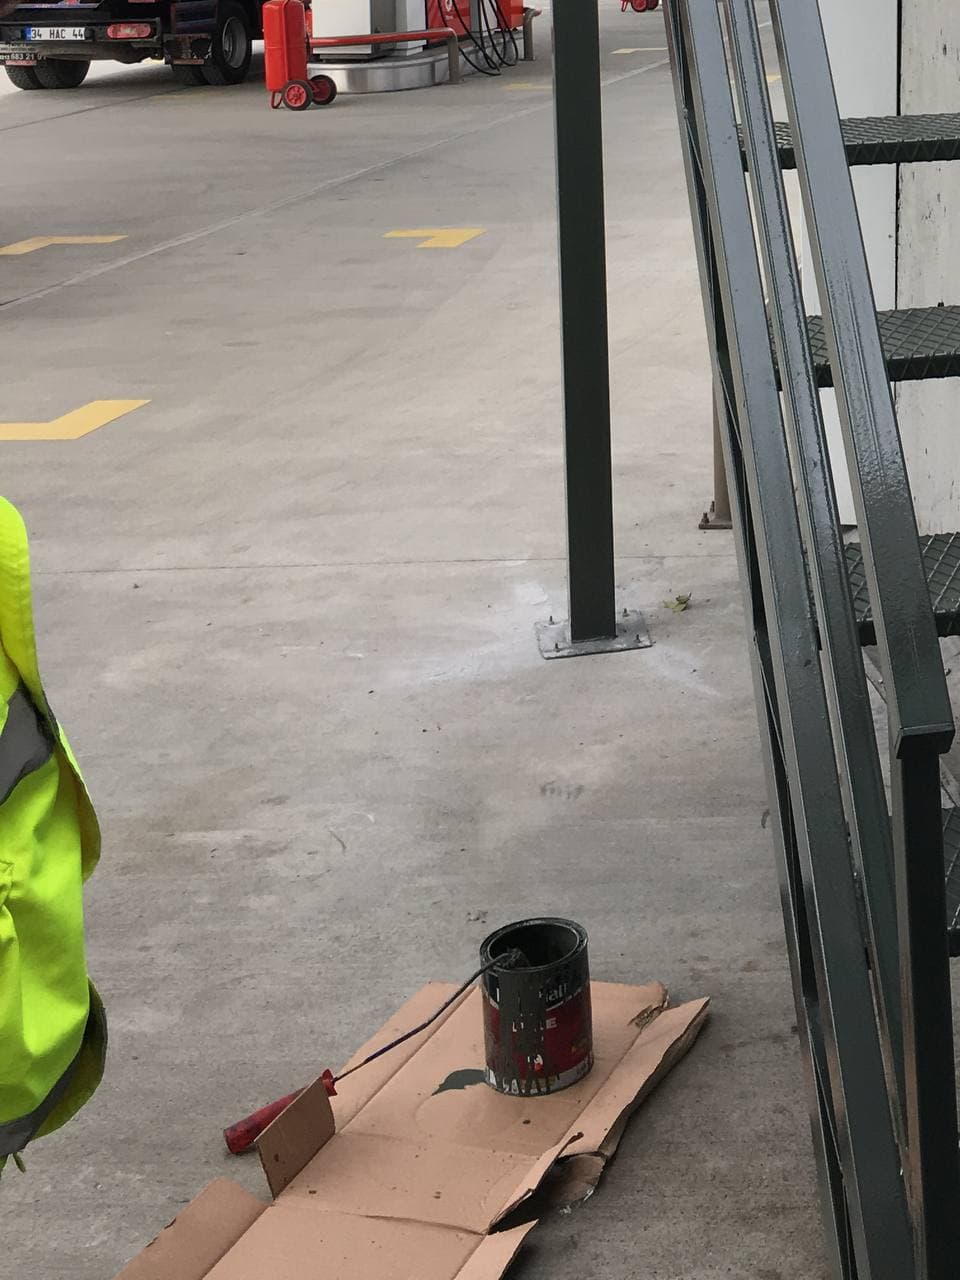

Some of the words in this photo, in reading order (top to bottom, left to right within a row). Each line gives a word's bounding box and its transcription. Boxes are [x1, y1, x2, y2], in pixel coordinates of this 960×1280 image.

[32, 28, 42, 39] 34
[49, 28, 66, 39] HAC
[72, 28, 84, 39] 44
